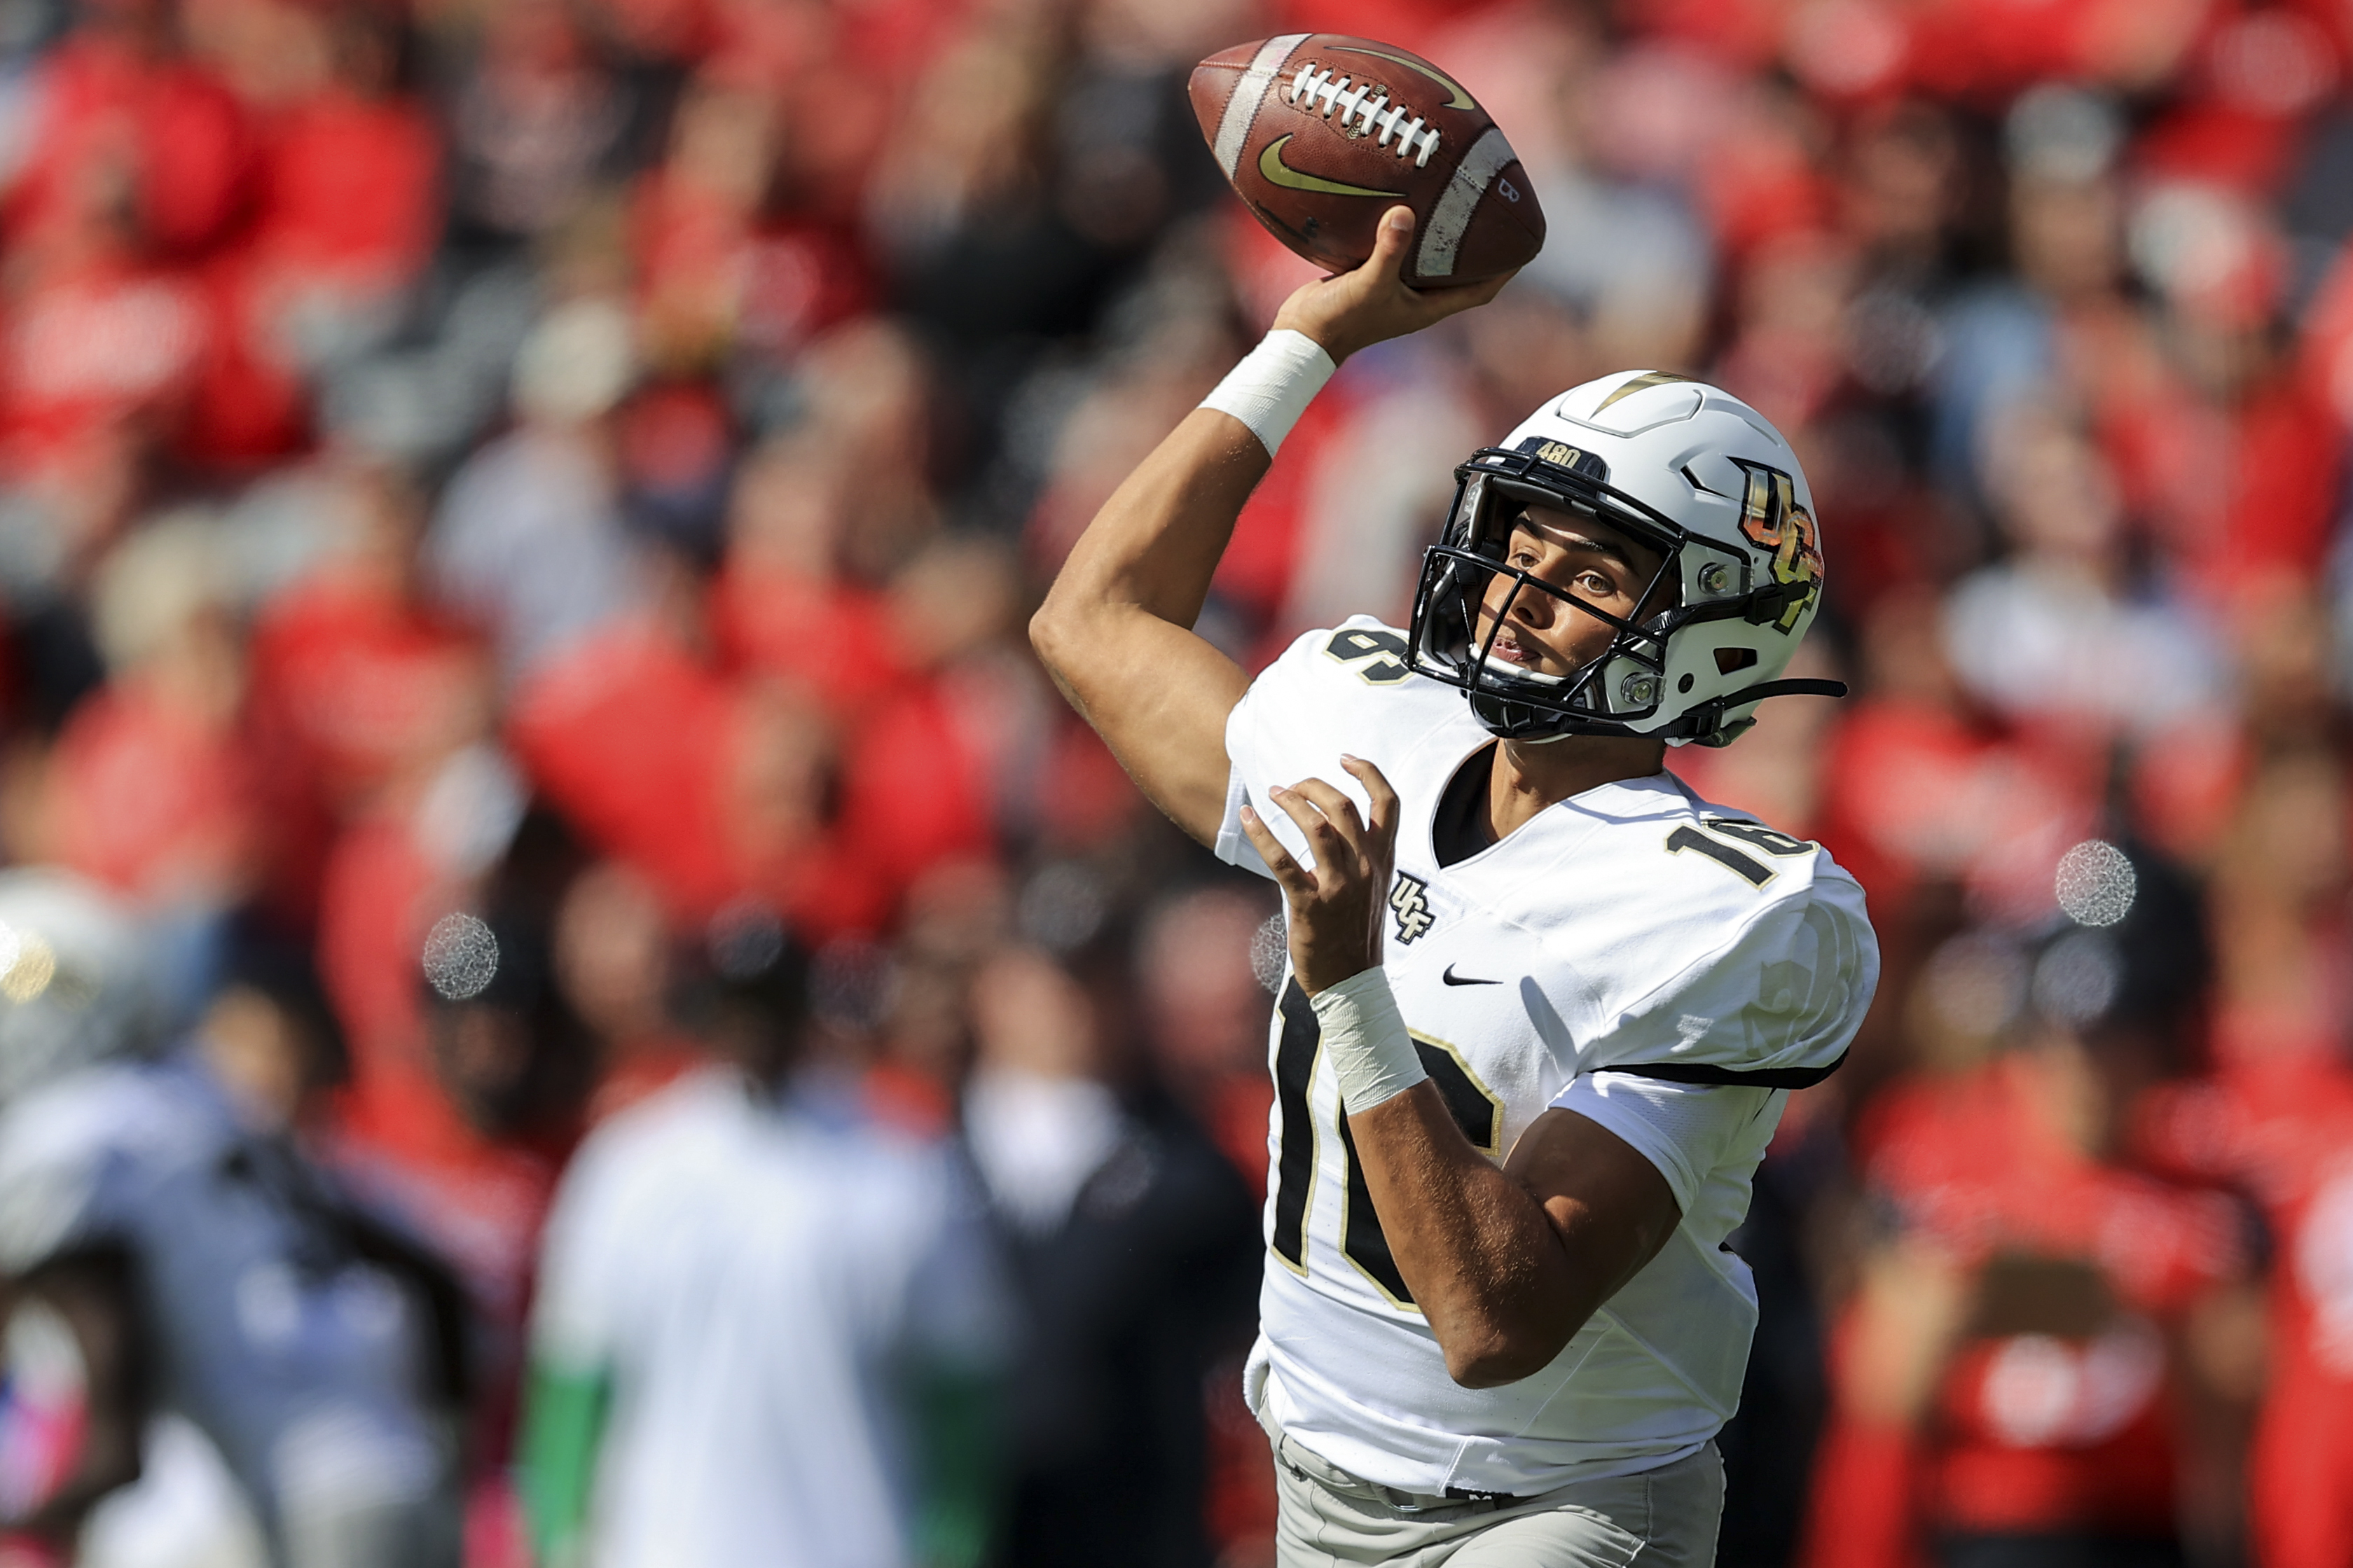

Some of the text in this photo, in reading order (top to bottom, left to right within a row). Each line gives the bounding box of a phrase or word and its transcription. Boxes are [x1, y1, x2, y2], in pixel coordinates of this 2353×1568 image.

[1535, 440, 1581, 469] 480
[1726, 456, 1825, 636] UCF
[1389, 868, 1437, 945] UCF
